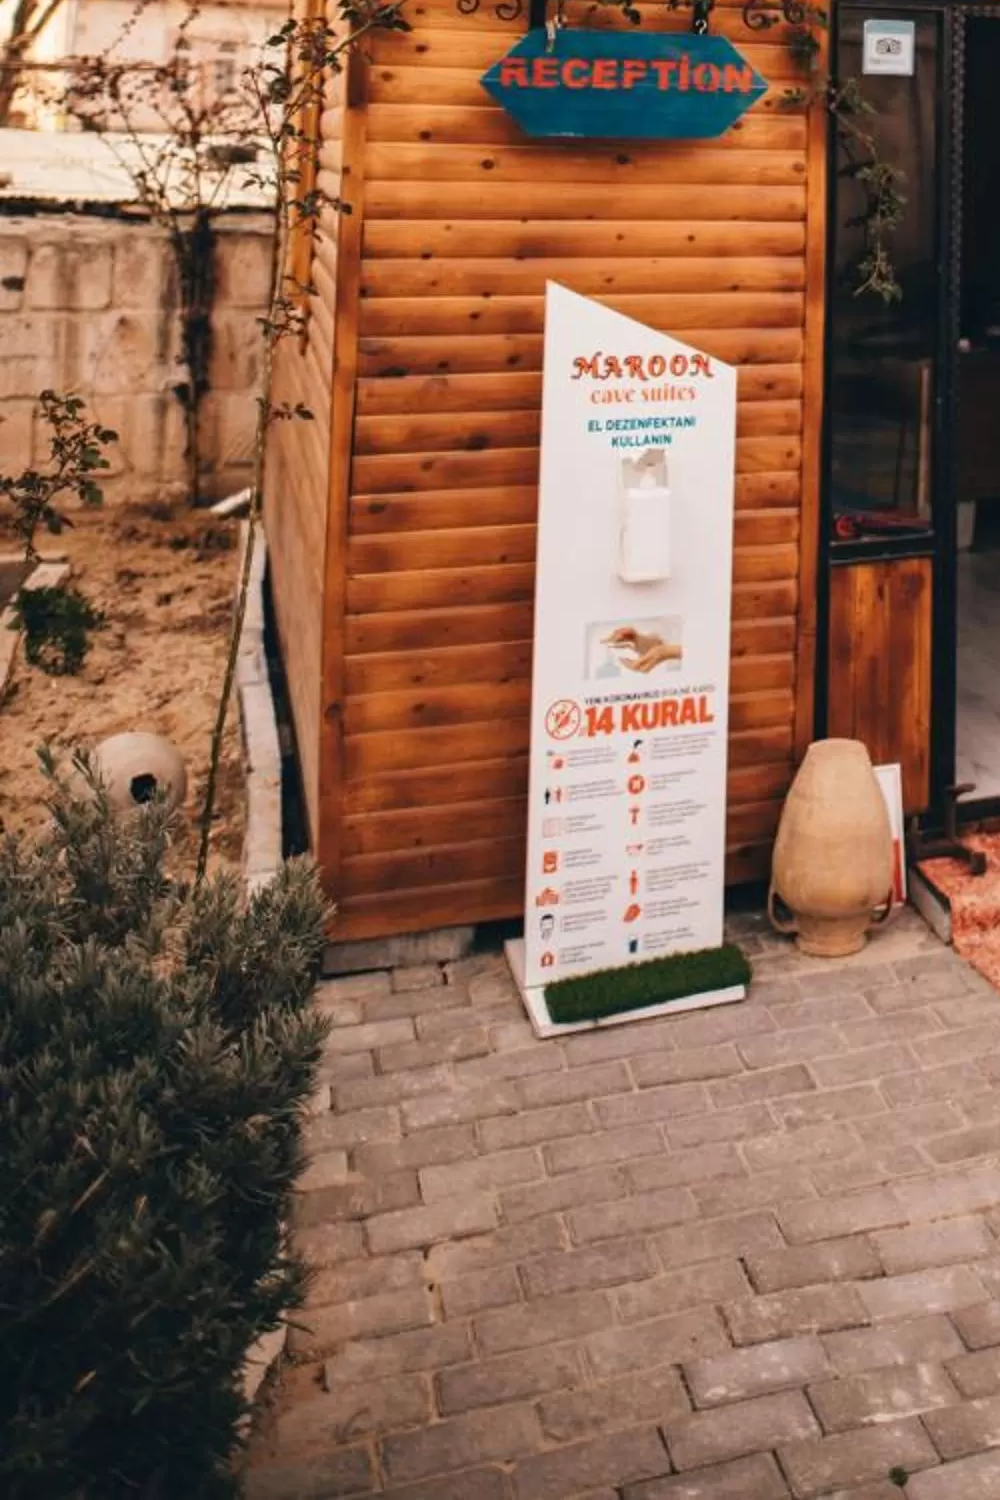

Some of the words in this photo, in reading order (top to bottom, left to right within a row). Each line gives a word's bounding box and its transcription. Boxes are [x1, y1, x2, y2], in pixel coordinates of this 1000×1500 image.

[571, 351, 715, 382] MAROON
[590, 388, 636, 404] cave
[641, 382, 696, 402] suites
[587, 419, 602, 432] EL
[605, 416, 696, 431] DEZENFEKTANI
[611, 434, 672, 448] KULLANIN
[585, 705, 614, 737] 14
[621, 695, 714, 732] KURAL
